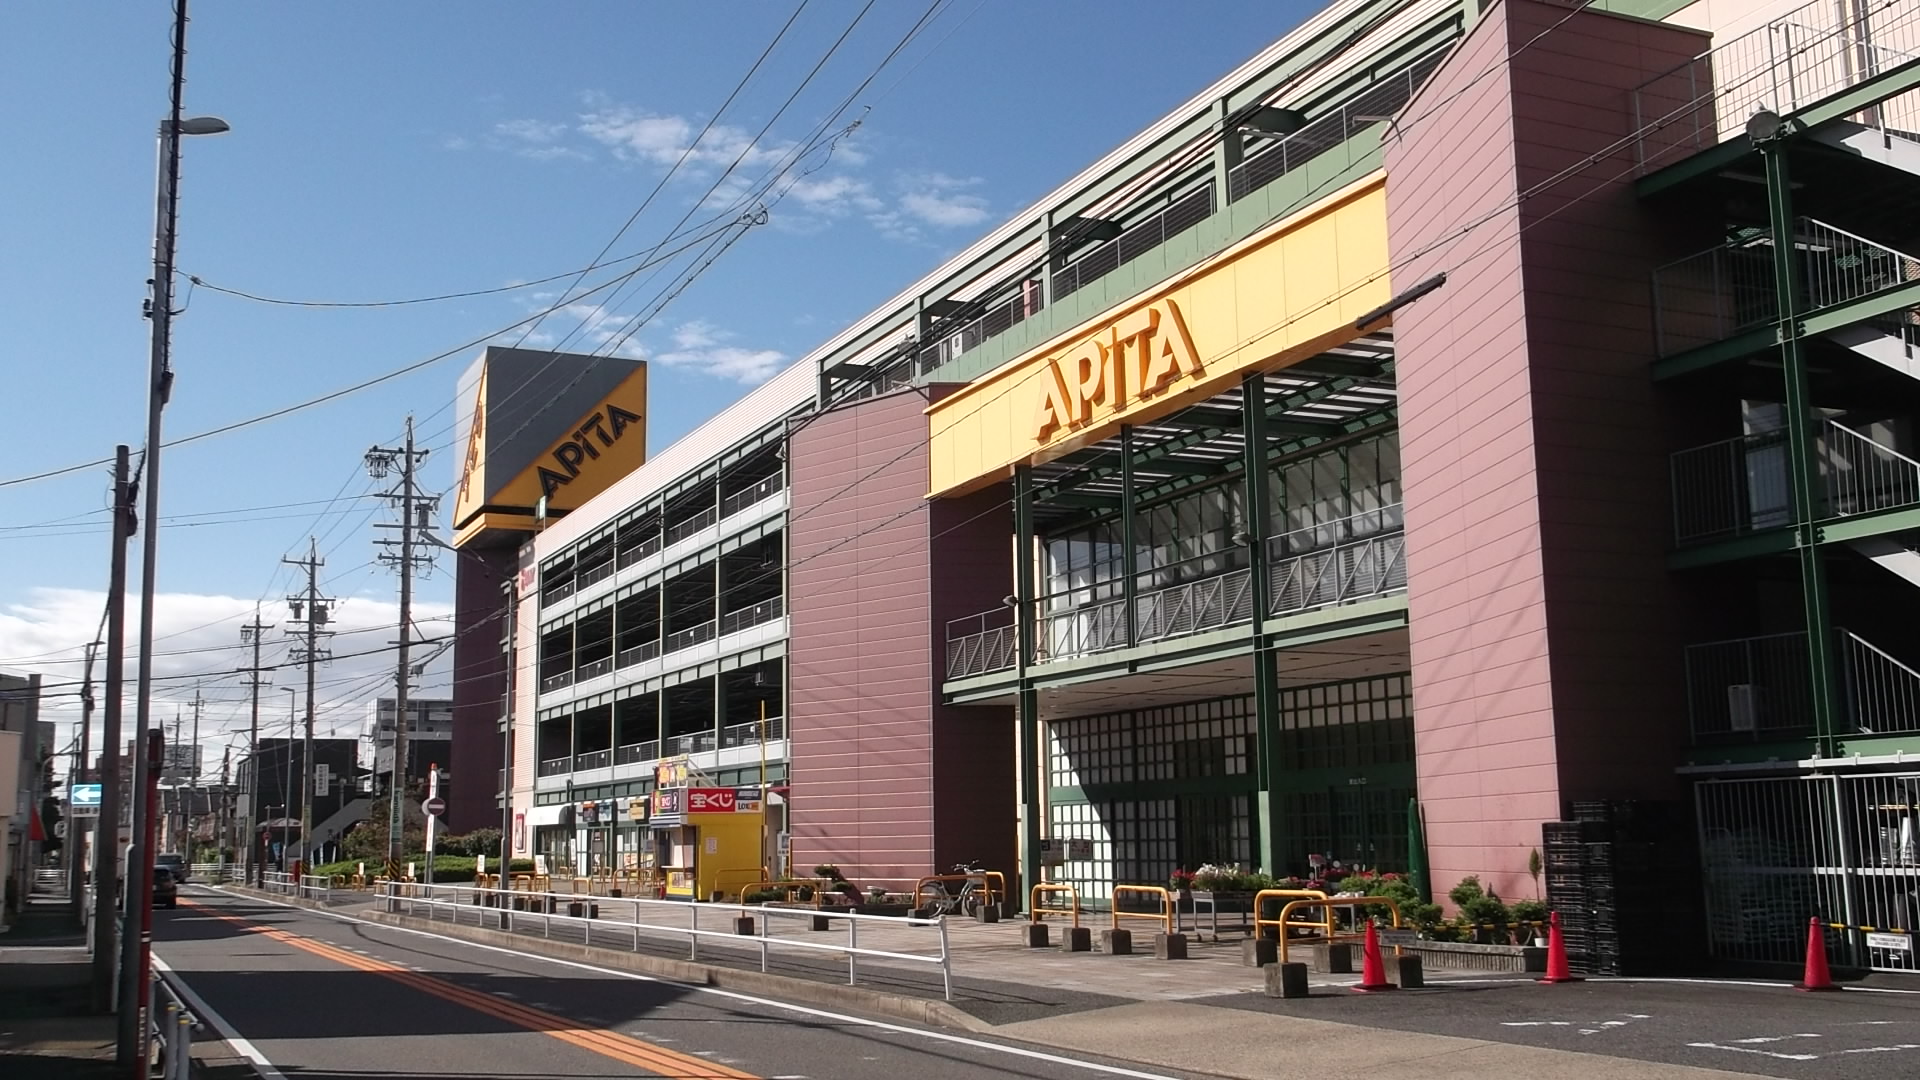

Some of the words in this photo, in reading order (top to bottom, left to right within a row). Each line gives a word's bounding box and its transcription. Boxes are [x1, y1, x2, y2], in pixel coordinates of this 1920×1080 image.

[1031, 298, 1207, 446] APITA
[537, 403, 642, 501] APITA
[689, 792, 734, 808] 宝くじ
